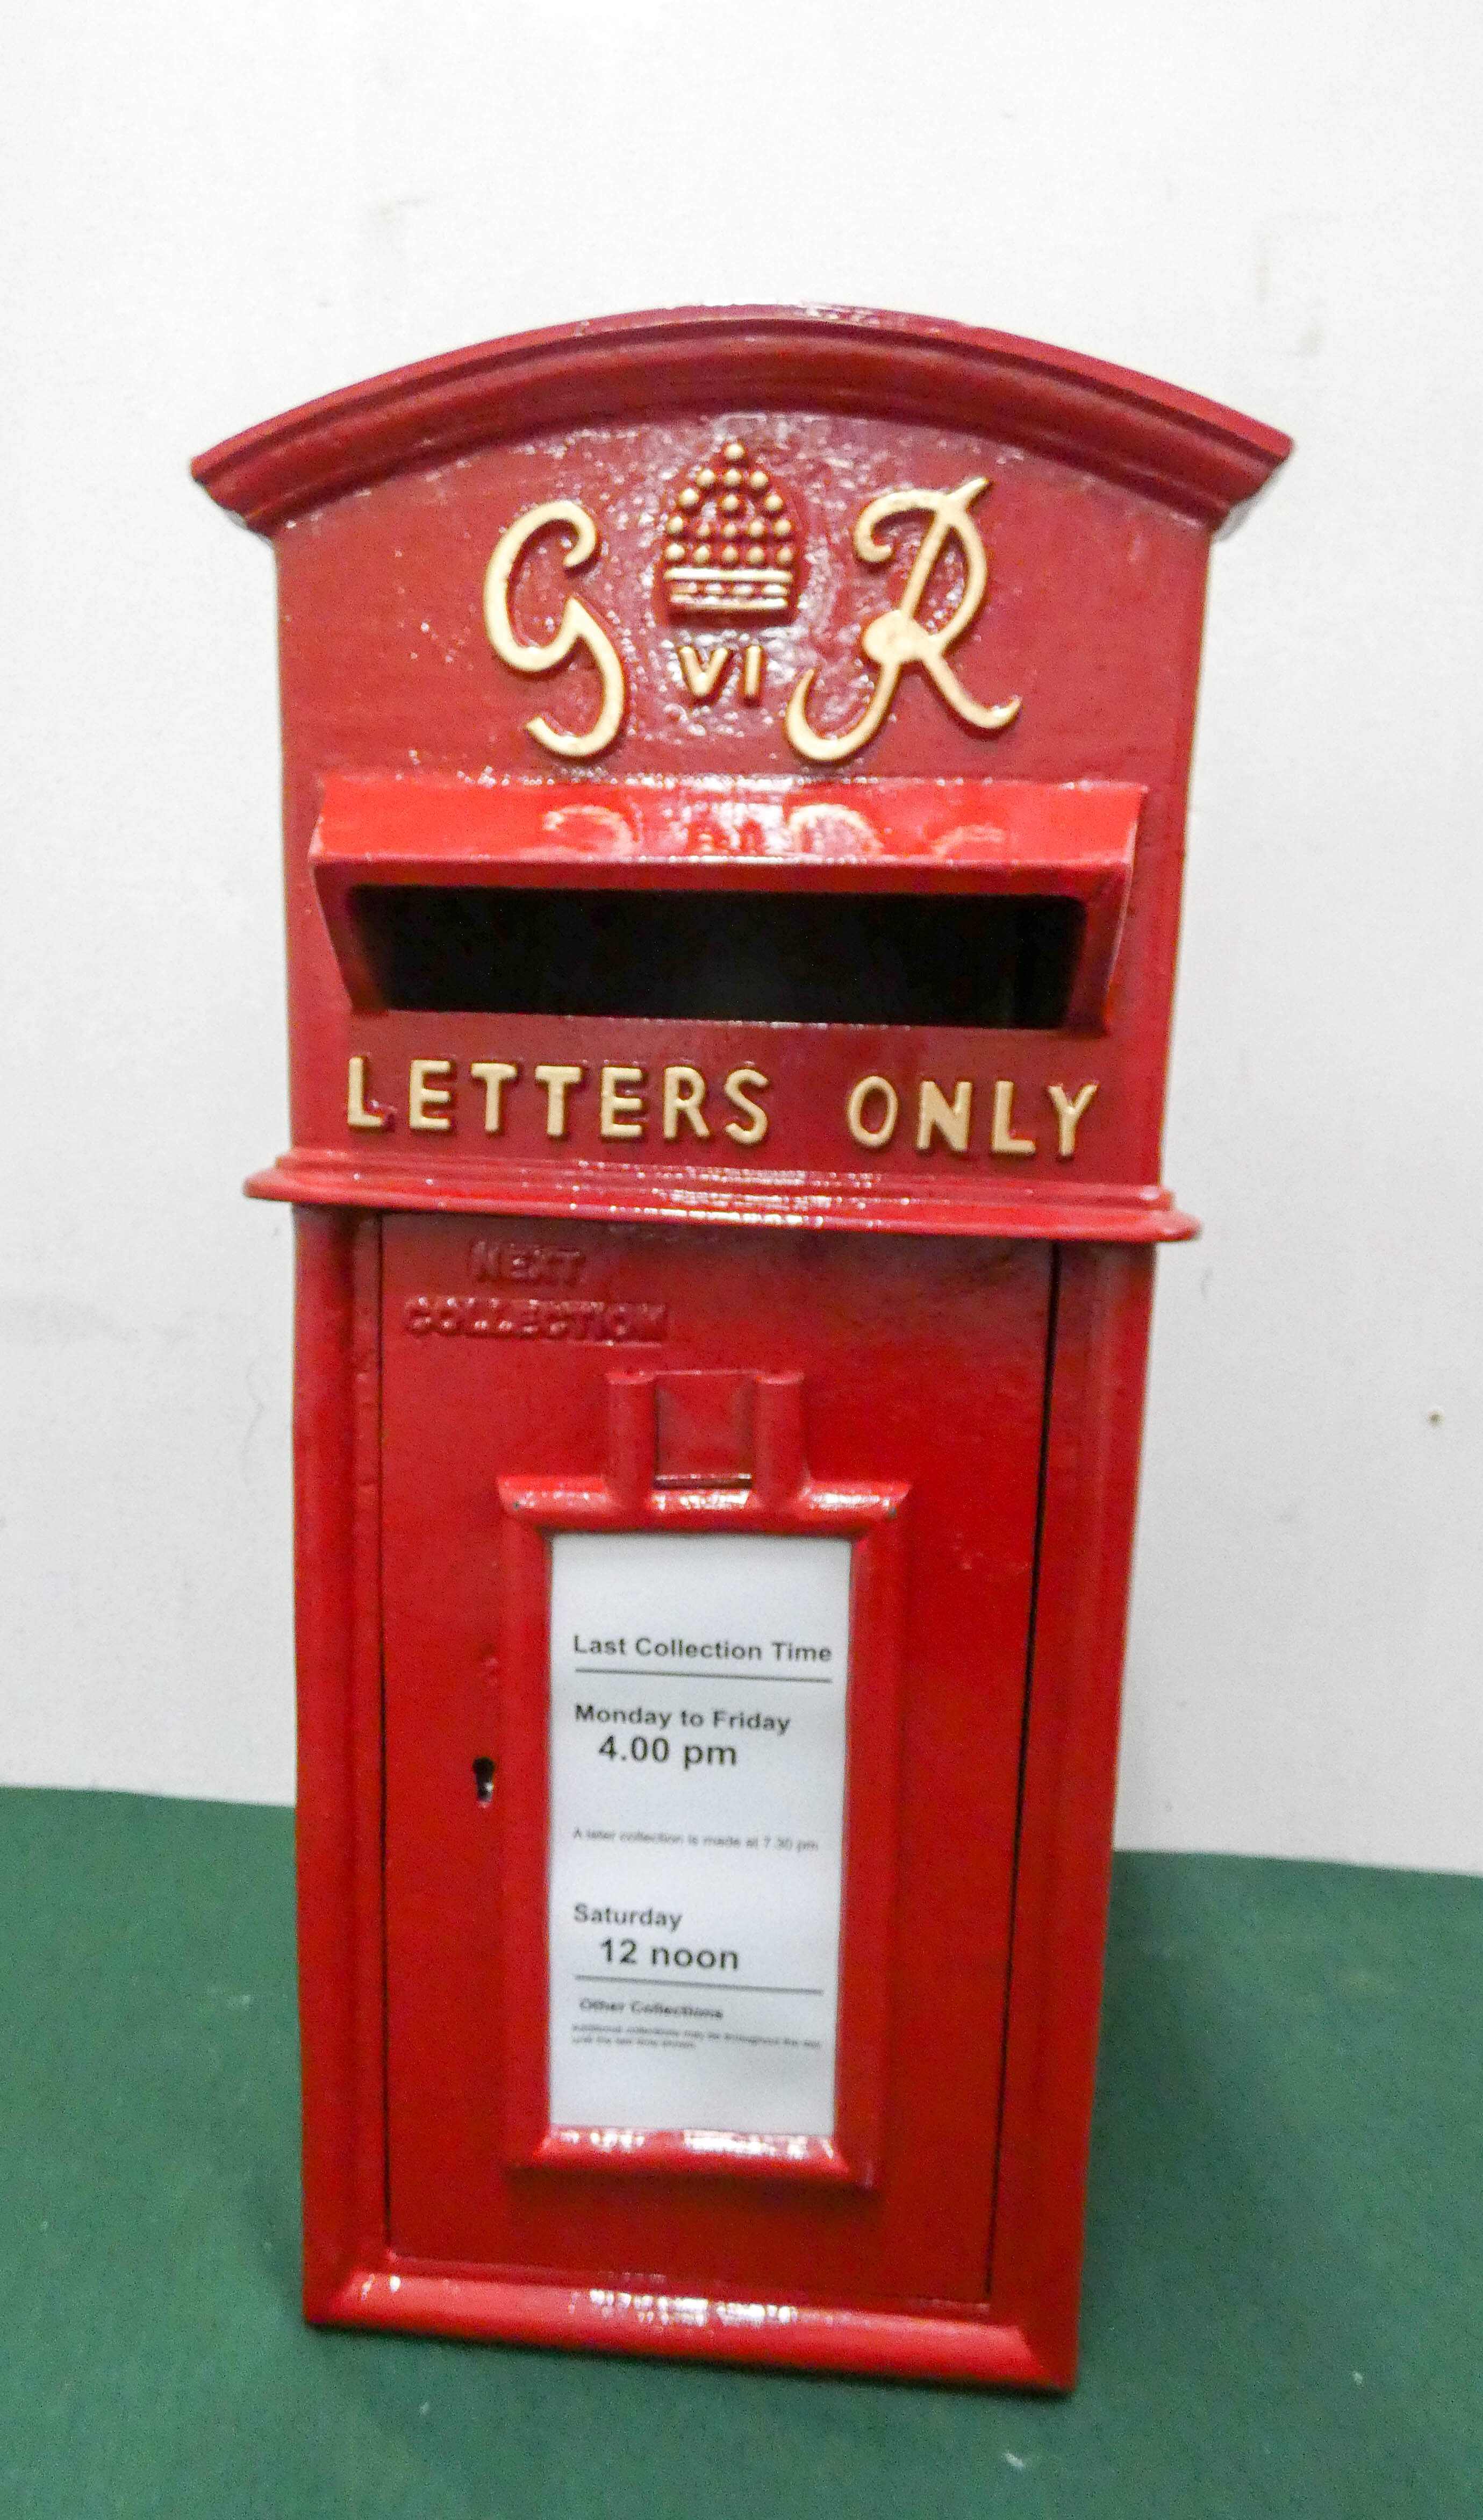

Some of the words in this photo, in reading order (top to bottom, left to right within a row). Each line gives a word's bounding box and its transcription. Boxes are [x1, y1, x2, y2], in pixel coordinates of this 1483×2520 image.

[678, 644, 762, 699] VI
[348, 1056, 769, 1145] LETTERS
[848, 1076, 1098, 1156] ONLY
[471, 1240, 583, 1283] NEXT
[404, 1295, 667, 1340] COLLECTION
[574, 1635, 626, 1655] Last
[635, 1637, 762, 1661] Collection
[771, 1641, 833, 1662] Time
[575, 1704, 671, 1730] Monday
[681, 1711, 704, 1728] to
[713, 1709, 791, 1736] Friday
[598, 1735, 670, 1763] 4.00
[684, 1744, 737, 1769] pm
[572, 1827, 582, 1839] A
[619, 1830, 684, 1846] collection
[689, 1834, 698, 1846] is
[703, 1835, 740, 1848] made
[574, 1902, 682, 1932] Saturday
[600, 1938, 637, 1965] 12
[651, 1946, 739, 1971] noon
